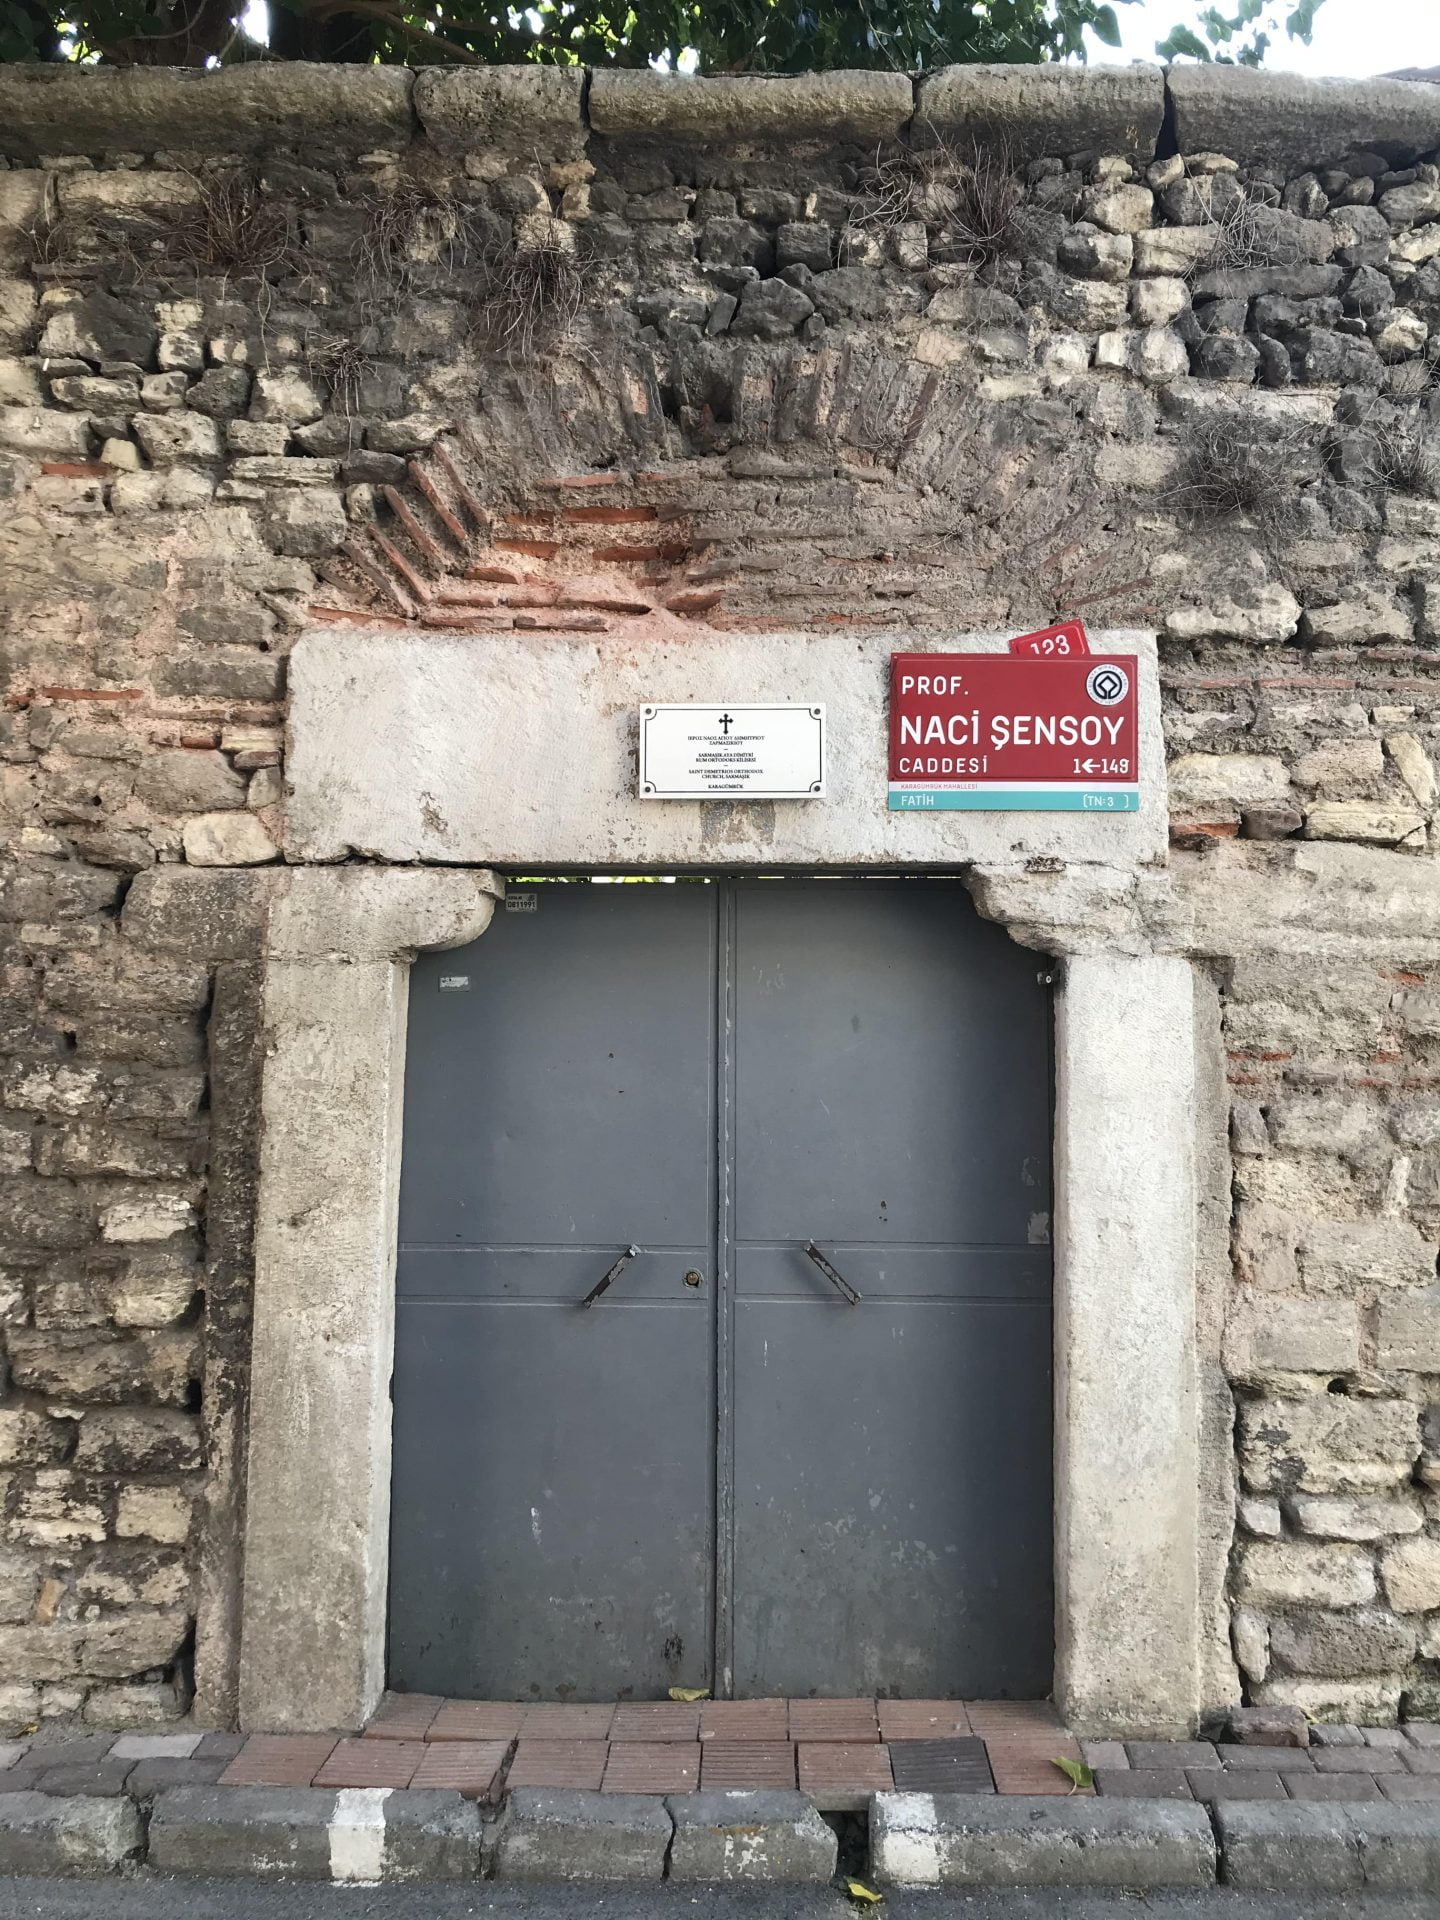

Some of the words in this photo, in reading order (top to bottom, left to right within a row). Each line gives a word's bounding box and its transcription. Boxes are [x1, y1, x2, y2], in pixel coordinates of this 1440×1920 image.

[1030, 634, 1070, 655] 123
[901, 676, 969, 695] PROF.
[900, 710, 979, 745] NACİ
[990, 715, 1125, 751] ŞENSOY
[899, 755, 988, 774] CADDESİ
[901, 793, 934, 806] FATİH
